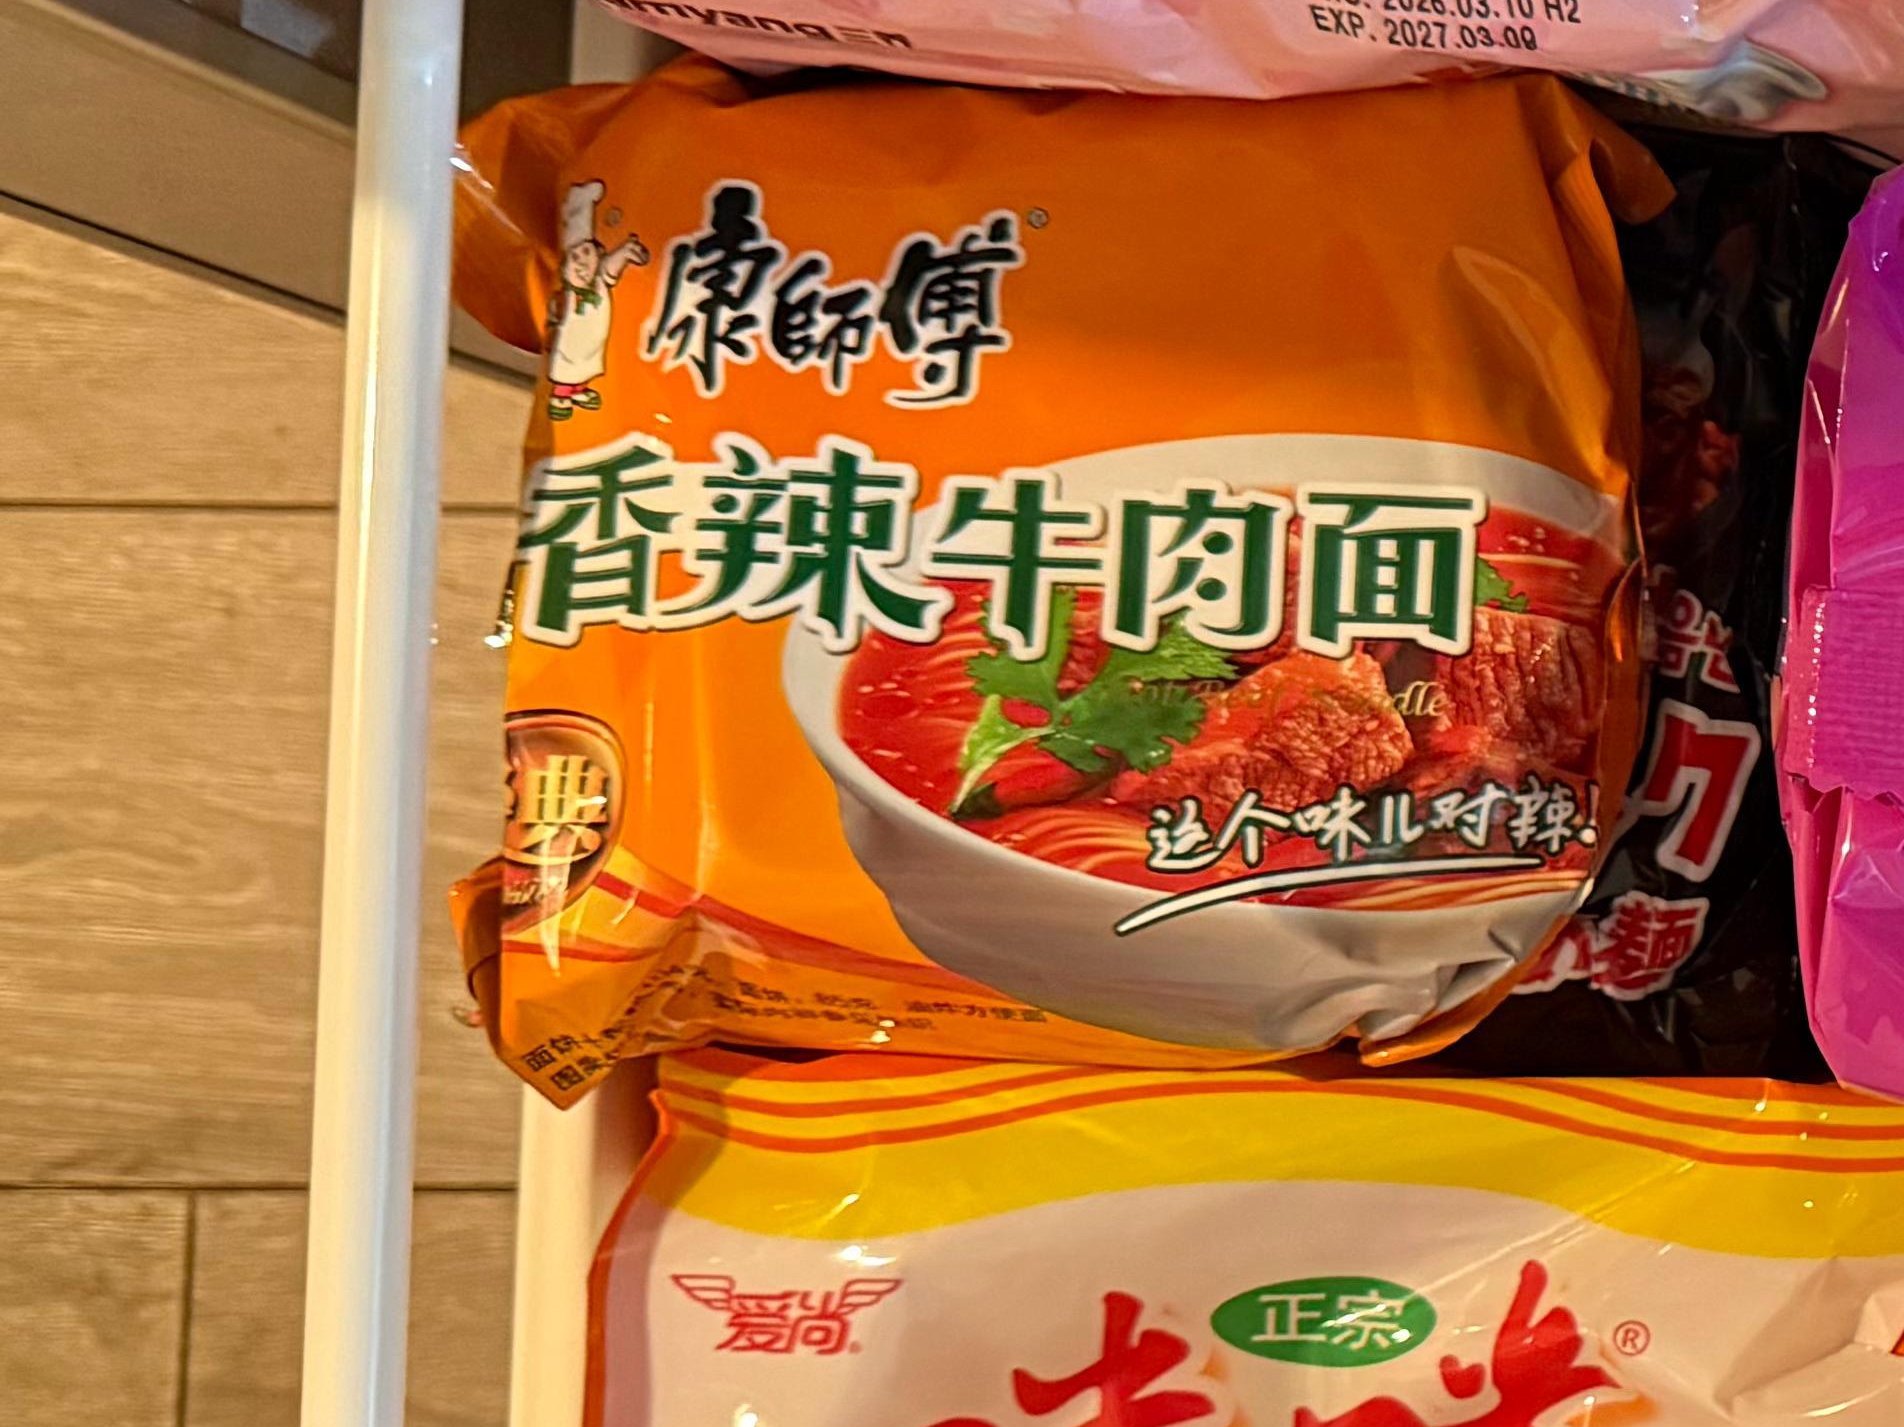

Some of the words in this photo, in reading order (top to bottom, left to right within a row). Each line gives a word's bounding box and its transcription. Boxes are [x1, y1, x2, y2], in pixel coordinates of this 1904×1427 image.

[1309, 5, 1376, 41] EXP.
[645, 184, 1022, 406] 康師傅
[518, 436, 1486, 660] 香辣牛肉面
[1252, 1292, 1408, 1350] 正宗
